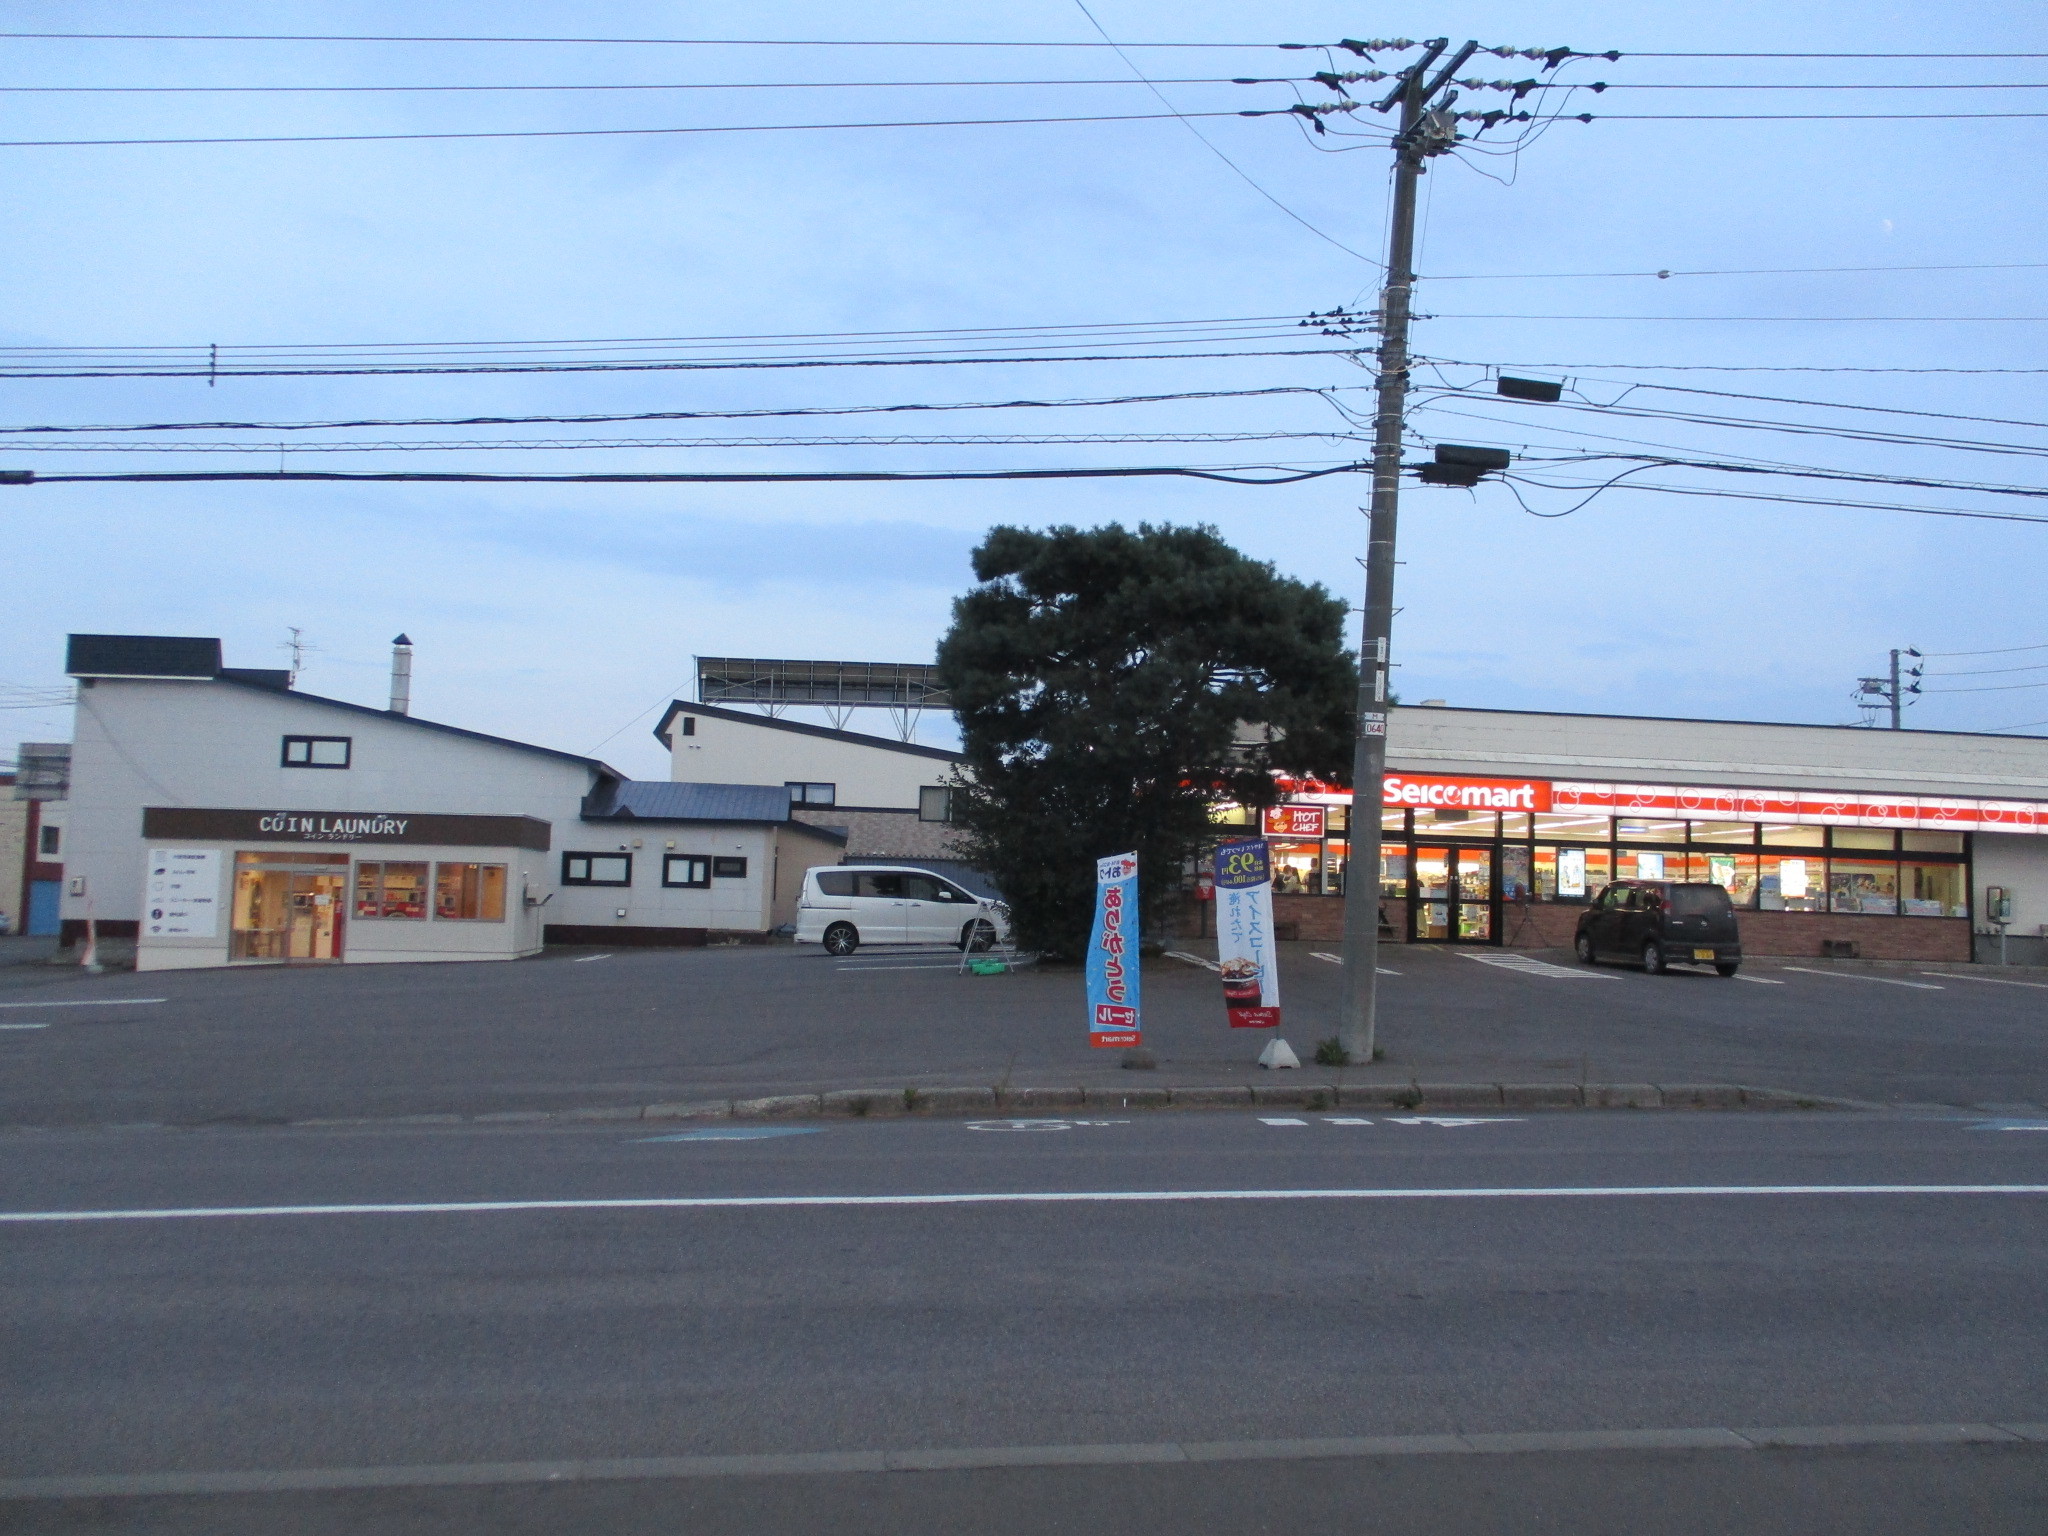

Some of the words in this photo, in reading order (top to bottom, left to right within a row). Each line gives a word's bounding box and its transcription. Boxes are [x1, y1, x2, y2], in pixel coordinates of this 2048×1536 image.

[1383, 778, 1535, 810] Seicomart
[259, 813, 314, 833] COIN
[320, 815, 408, 835] LAUNDRY
[1292, 811, 1320, 823] HOT
[1292, 822, 1320, 833] CHEF
